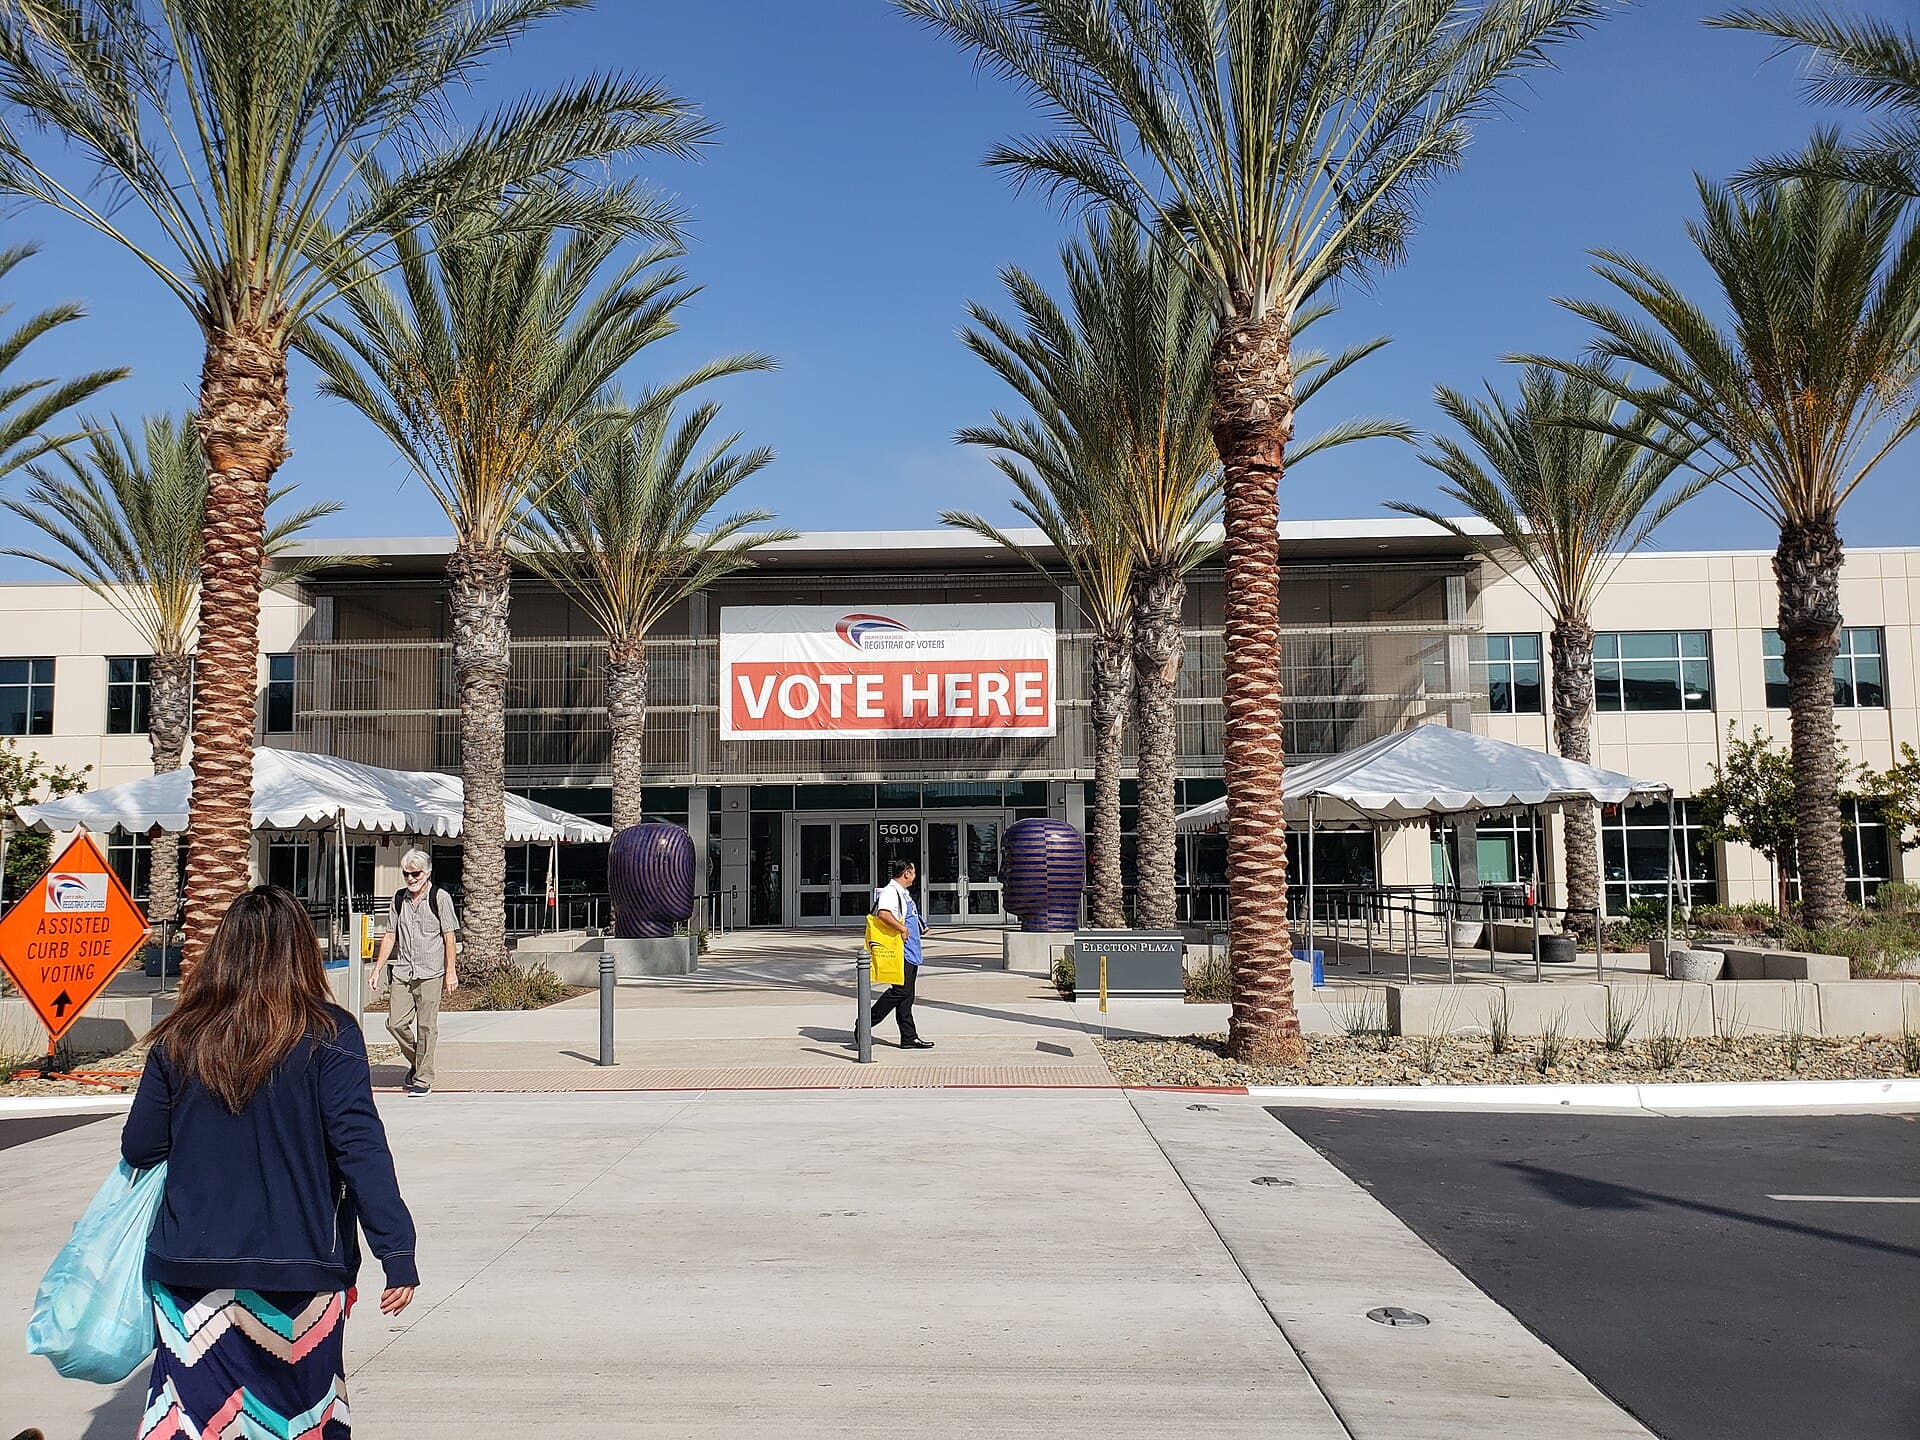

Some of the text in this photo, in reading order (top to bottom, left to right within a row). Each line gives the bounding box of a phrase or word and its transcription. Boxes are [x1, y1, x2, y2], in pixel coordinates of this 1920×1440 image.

[864, 640, 945, 650] REGISTRAR OF VOTERS
[736, 672, 1044, 719] VOTE HERE
[880, 824, 918, 834] 5600
[36, 917, 110, 935] ASSISTED
[27, 940, 112, 959] CURB SIDE
[41, 964, 95, 983] VOTING
